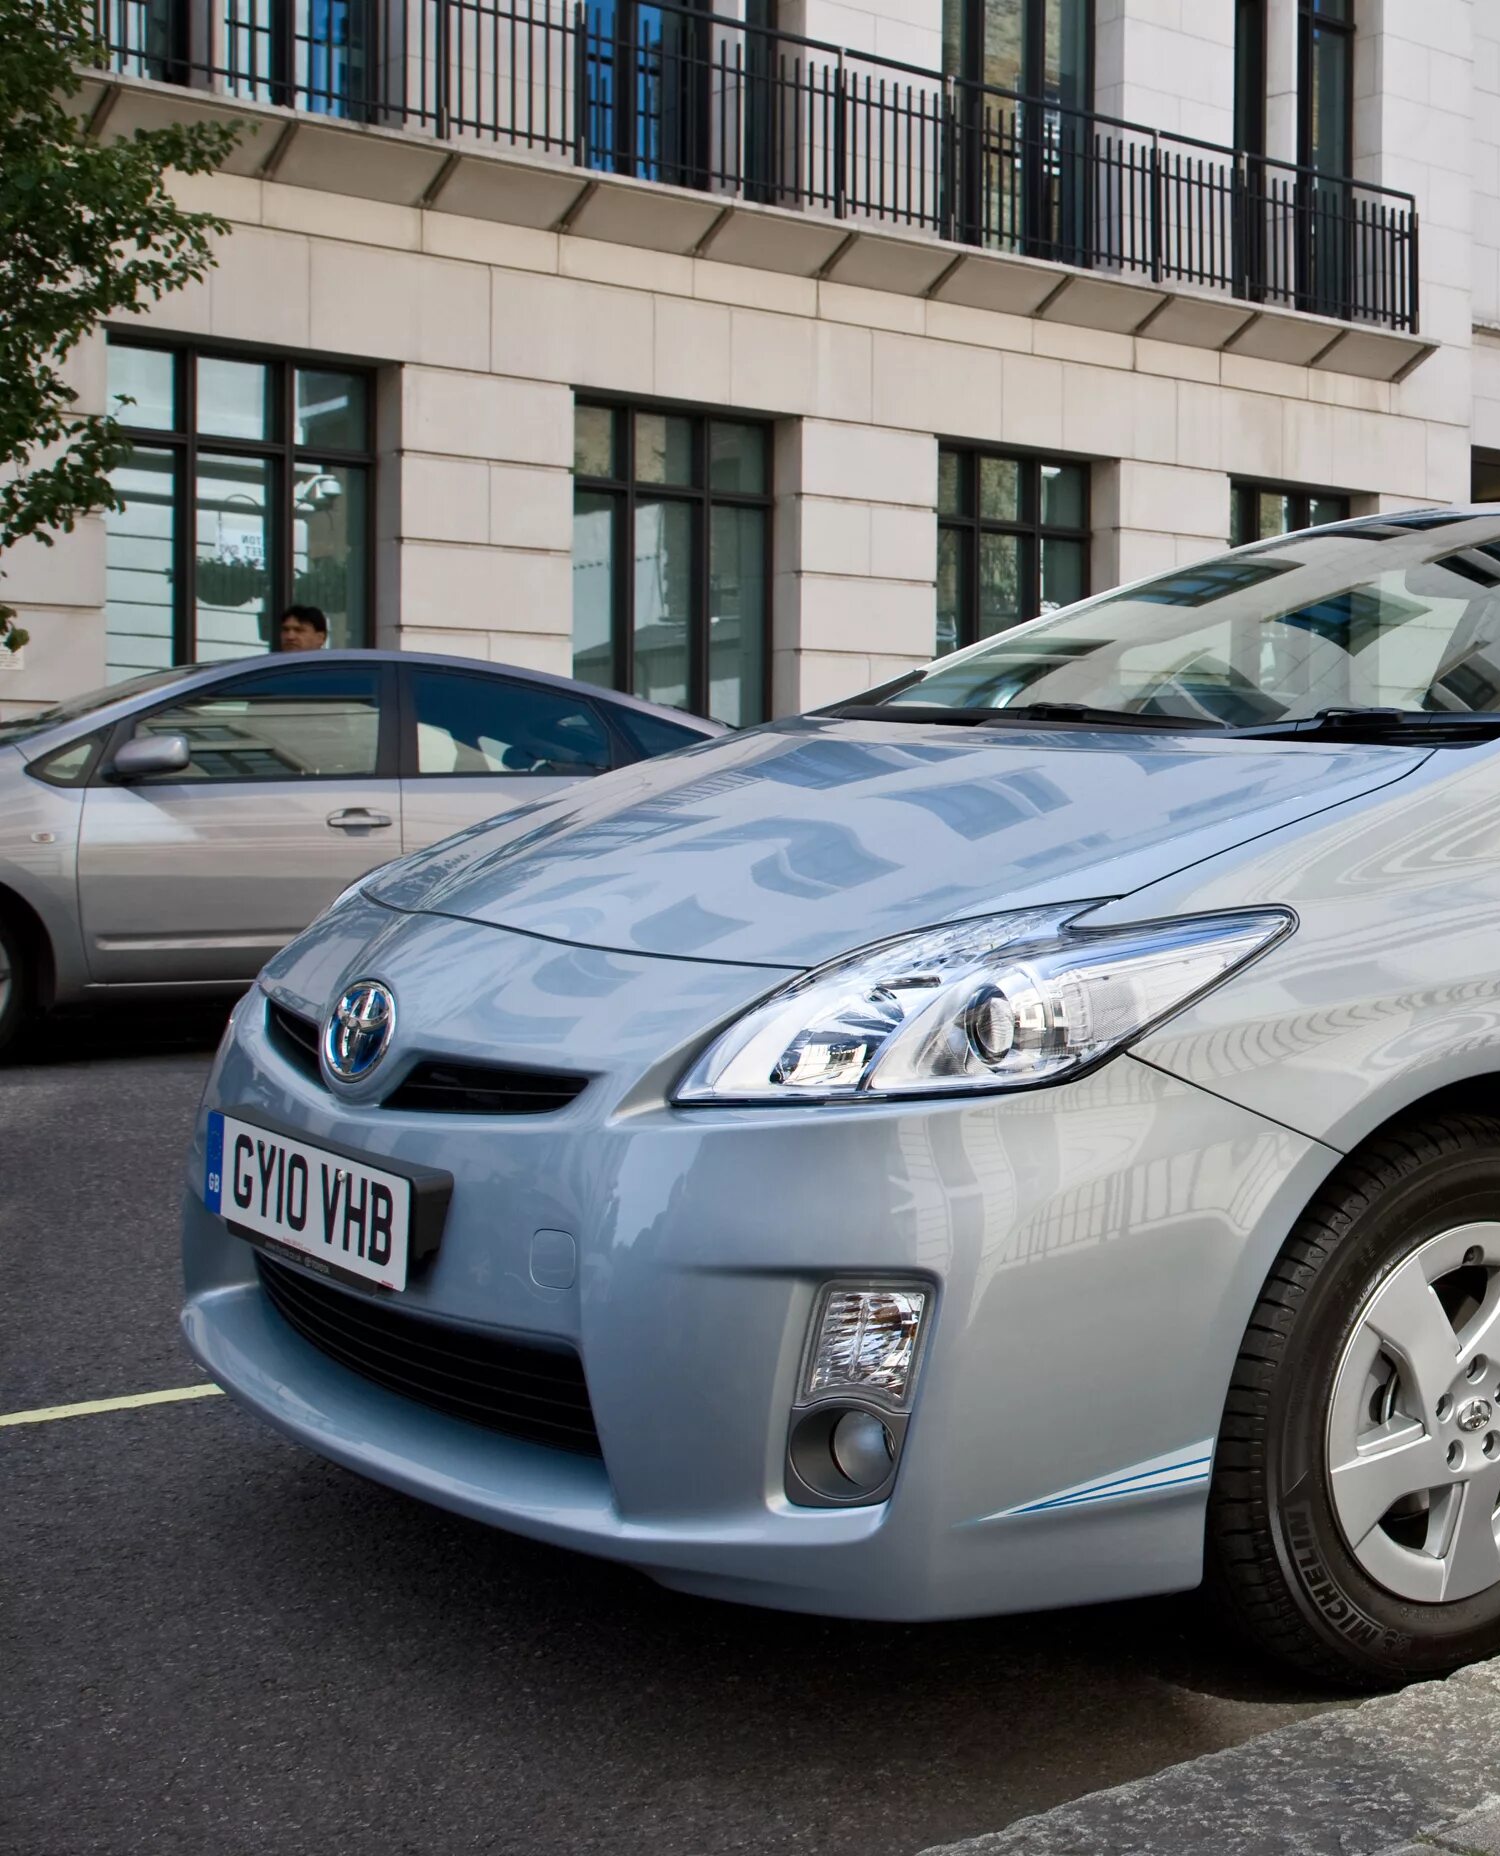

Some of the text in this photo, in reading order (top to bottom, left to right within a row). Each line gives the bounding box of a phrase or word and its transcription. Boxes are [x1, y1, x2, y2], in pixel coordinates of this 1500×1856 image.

[208, 1172, 220, 1193] GB
[234, 1133, 393, 1267] GY10 VHB
[1286, 1511, 1381, 1647] MICHELIN
